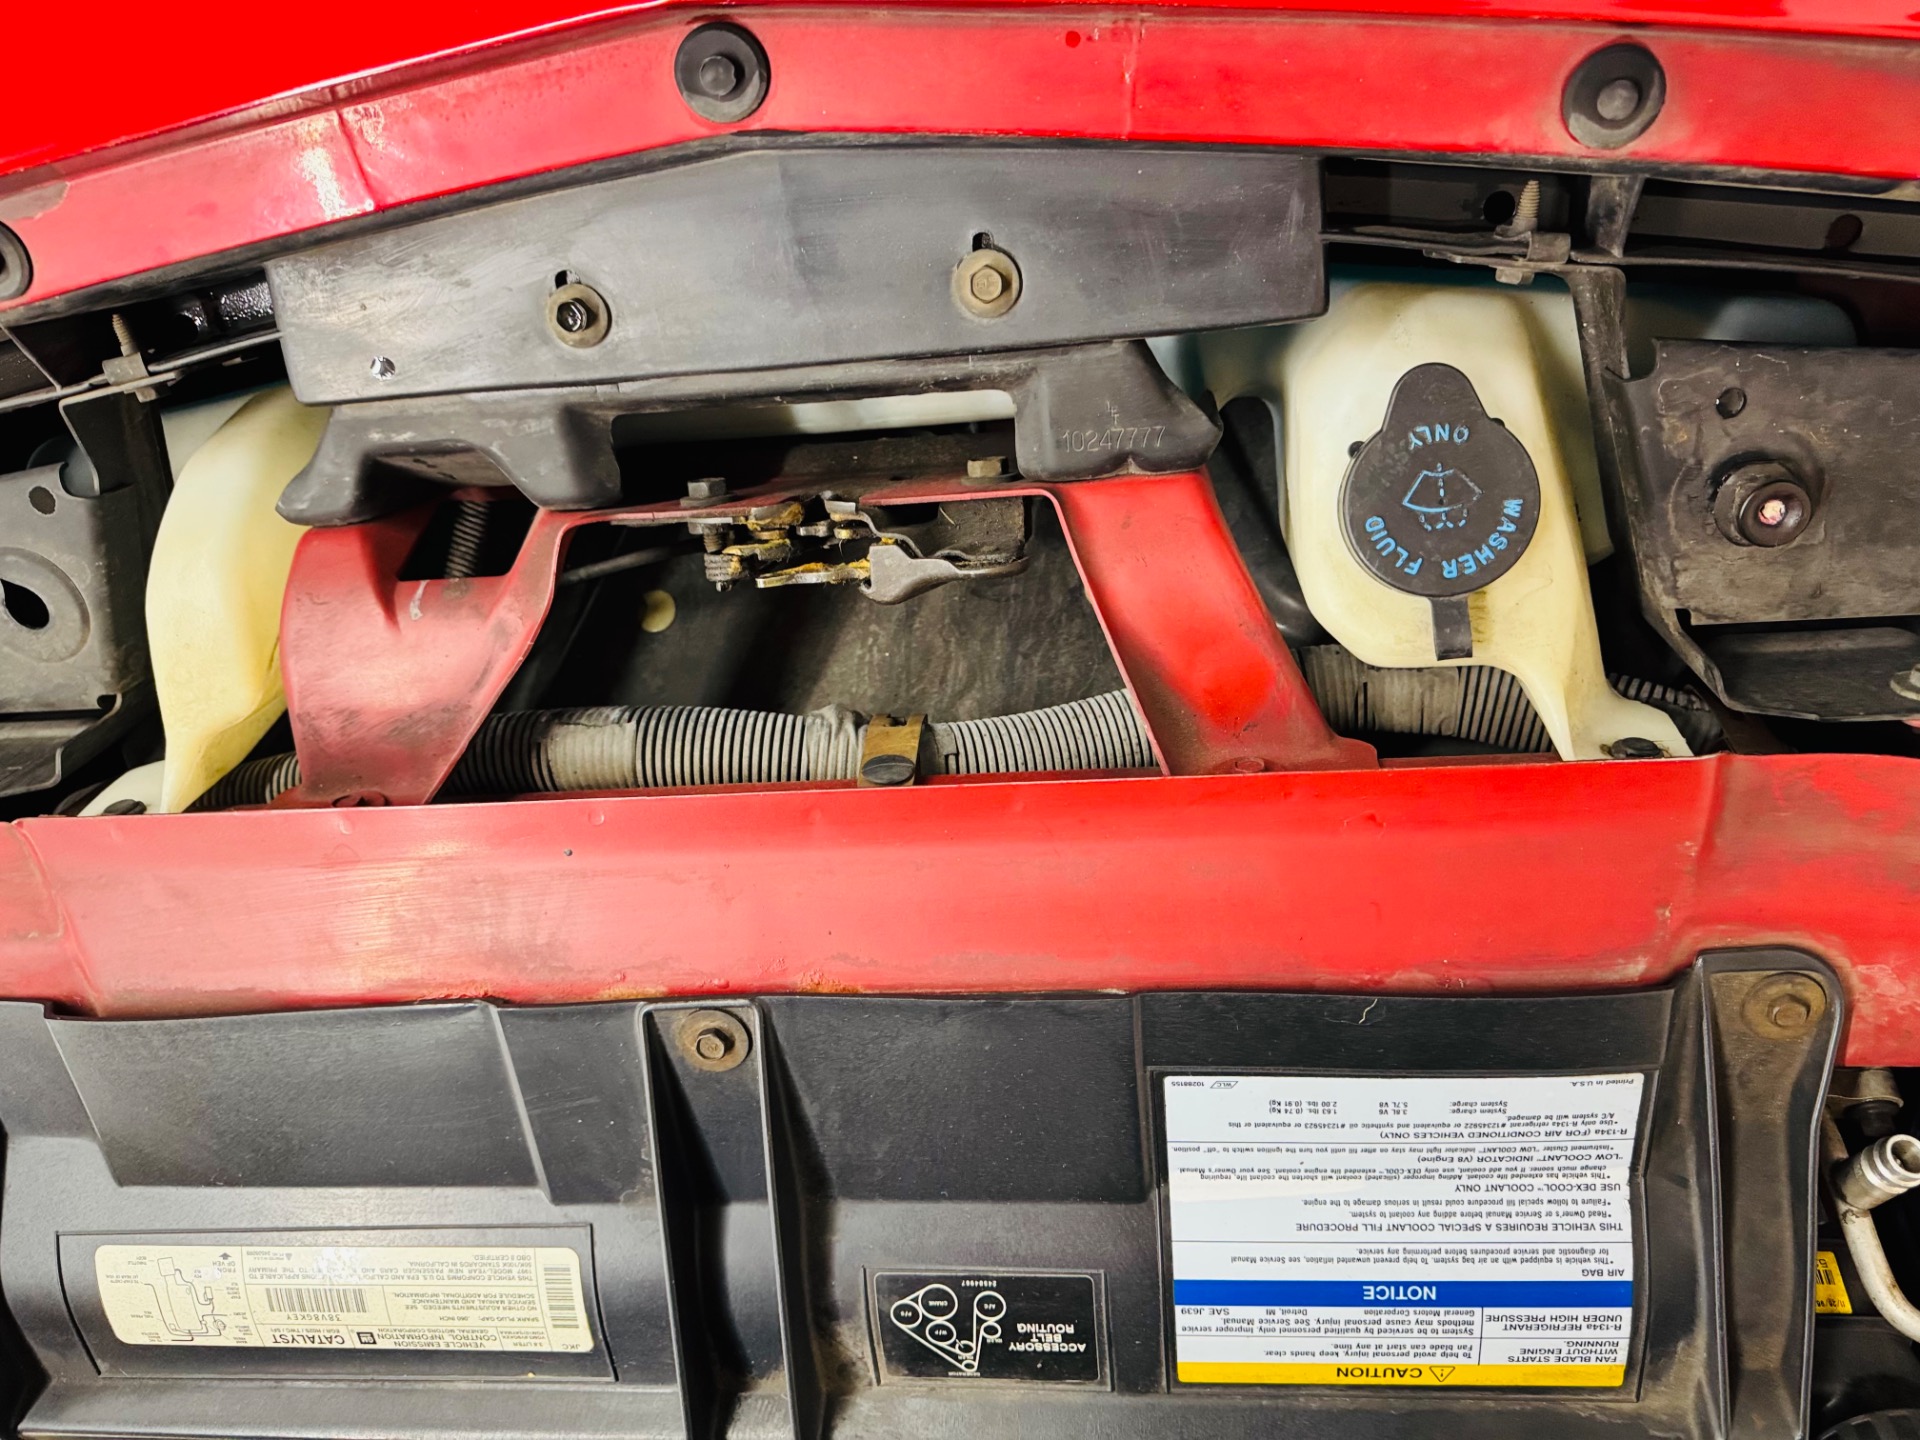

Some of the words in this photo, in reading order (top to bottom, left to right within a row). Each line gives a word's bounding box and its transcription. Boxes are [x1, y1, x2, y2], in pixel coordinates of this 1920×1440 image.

[1062, 426, 1166, 452] 10247777
[1408, 423, 1470, 450] ONLY
[1442, 498, 1524, 578] WASHER
[1365, 516, 1423, 576] FLUID
[1418, 1155, 1455, 1164] Engine)
[1455, 1184, 1482, 1193] ONLY
[1486, 1184, 1535, 1193] COOLANT
[1601, 1183, 1621, 1192] USE
[1433, 1210, 1458, 1219] adding
[1486, 1211, 1513, 1219] Manual
[1515, 1211, 1543, 1219] Service
[1555, 1211, 1586, 1219] Owner's
[1588, 1211, 1607, 1219] Read
[1296, 1224, 1359, 1232] PROCEDURE
[1362, 1224, 1383, 1232] FILL
[1387, 1224, 1436, 1232] COOLANT
[1439, 1224, 1482, 1232] SPECIAL
[1485, 1224, 1493, 1232] A
[1496, 1223, 1549, 1232] REQUIRES
[1552, 1223, 1596, 1232] VEHICLE
[1599, 1223, 1622, 1232] THIS
[1582, 1269, 1604, 1277] BAG
[1363, 1286, 1437, 1301] NOTICE
[287, 1314, 341, 1322] 38V8GKEY
[1017, 1324, 1075, 1334] ROUTING
[1216, 1324, 1254, 1333] Improper
[1279, 1325, 1322, 1334] personnel
[1364, 1327, 1375, 1335] by
[1442, 1328, 1474, 1336] System
[273, 1334, 346, 1345] CATALYST
[1031, 1332, 1063, 1343] BELT
[1009, 1341, 1087, 1353] ACCESSORY
[1342, 1349, 1370, 1358] injury,
[1372, 1349, 1411, 1358] personal
[1440, 1350, 1460, 1359] help
[1462, 1350, 1472, 1359] To
[1337, 1368, 1422, 1379] CAUTION
